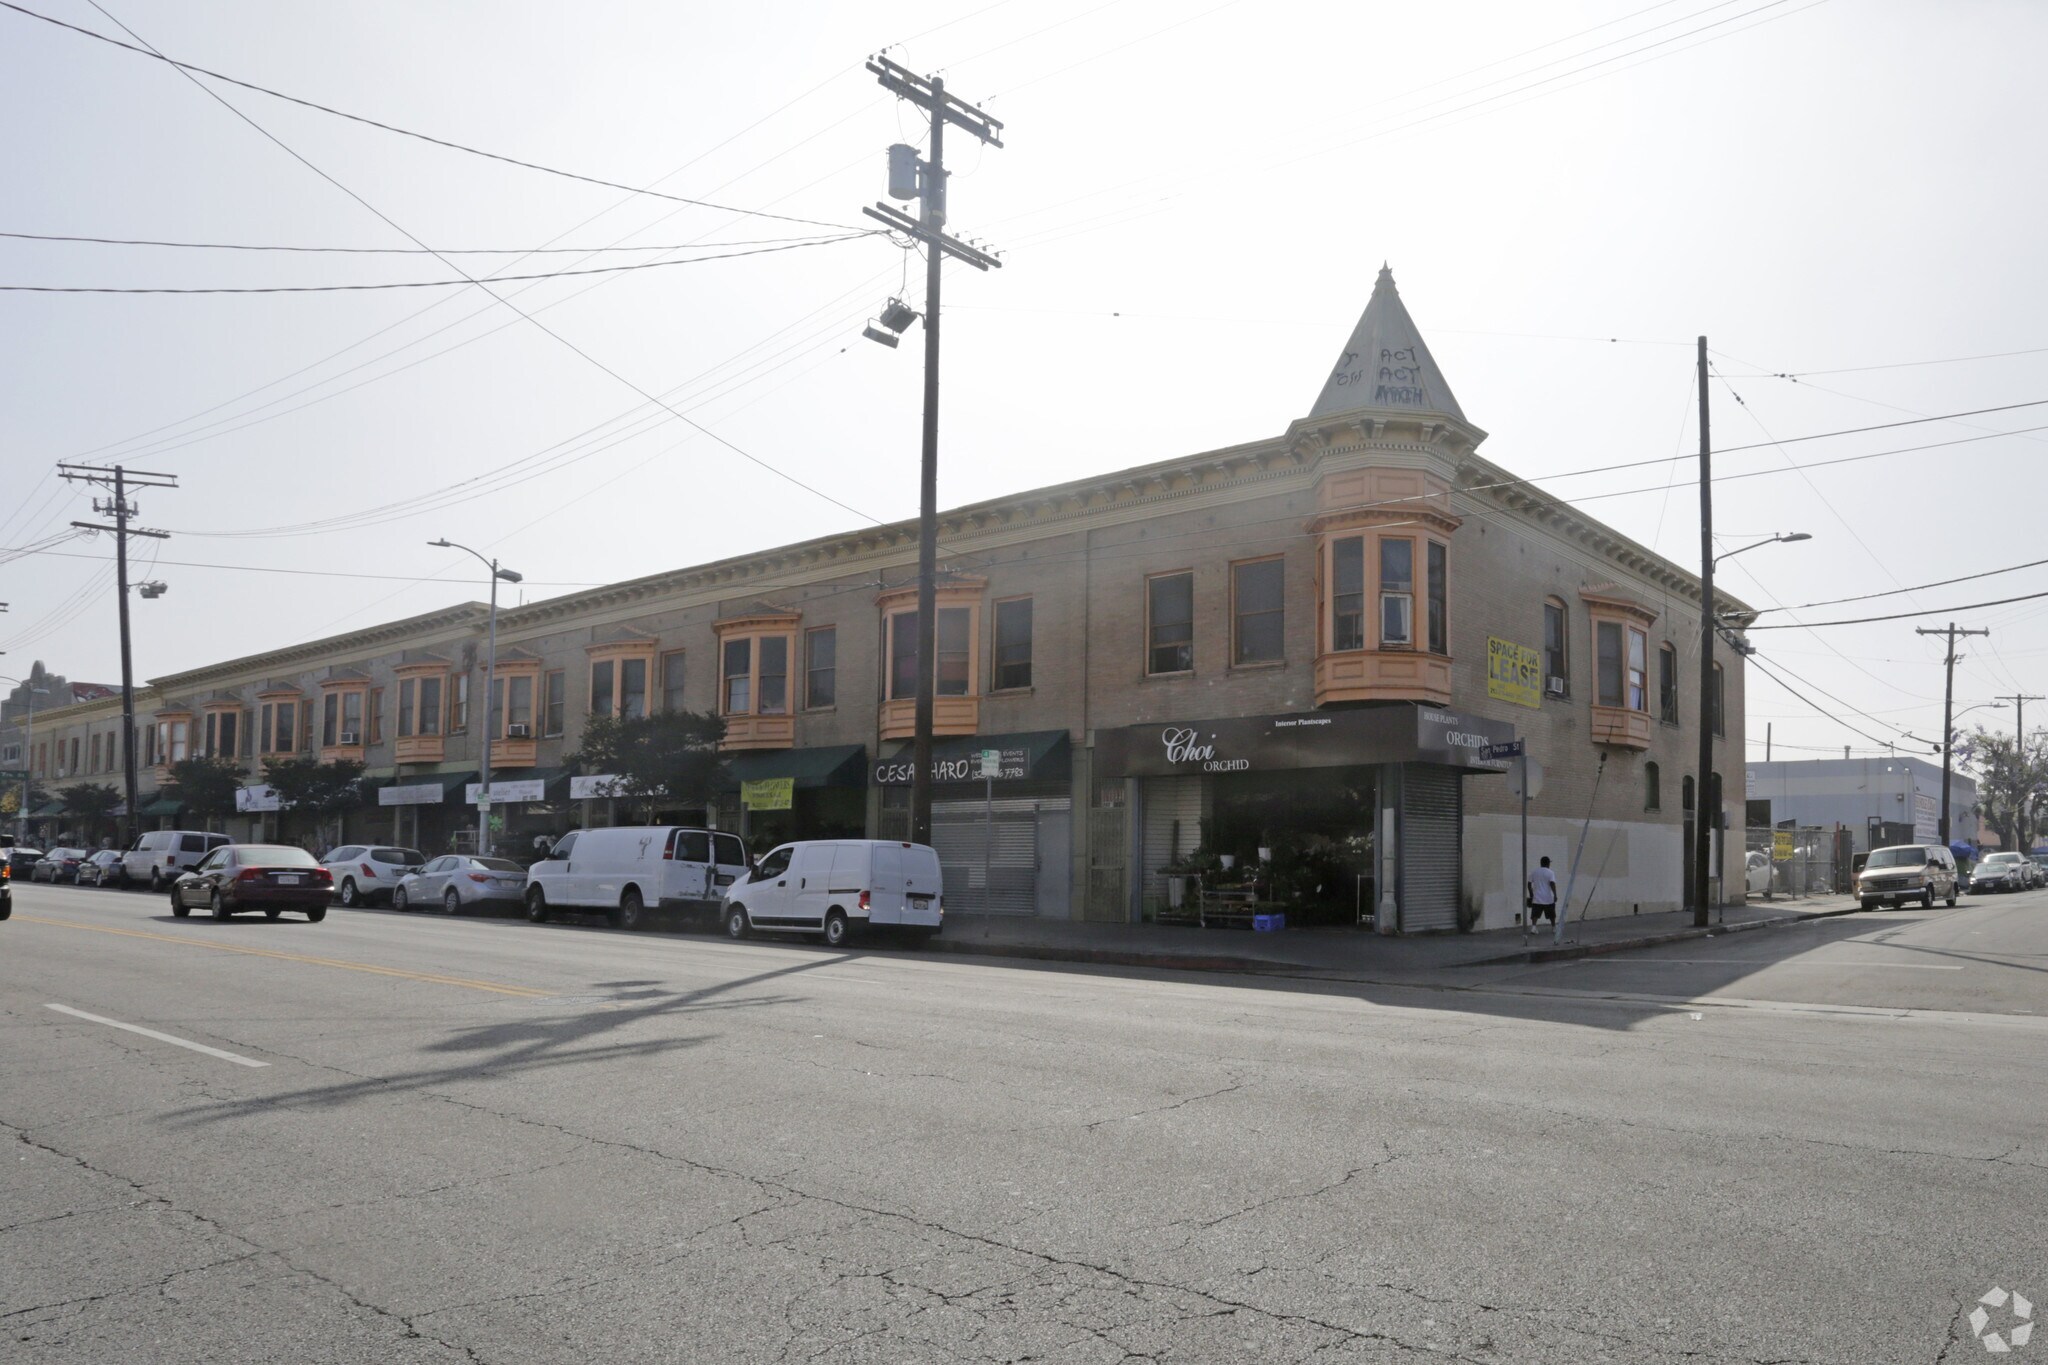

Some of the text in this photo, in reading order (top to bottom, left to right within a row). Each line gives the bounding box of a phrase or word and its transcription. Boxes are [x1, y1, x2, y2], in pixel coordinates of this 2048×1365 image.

[1380, 347, 1416, 363] ACT
[1379, 366, 1420, 384] ACT
[1490, 640, 1538, 667] SPACE FOR
[1490, 656, 1538, 690] LEASE
[1275, 718, 1332, 727] Interior Plantscapes
[1423, 711, 1459, 725] HOUSE PLANTS
[1161, 727, 1217, 765] Choi
[1446, 731, 1489, 748] ORCHIDS
[1492, 745, 1508, 753] Pedro
[1512, 743, 1520, 751] St
[875, 763, 915, 783] CESA
[1204, 759, 1249, 772] ORCHID
